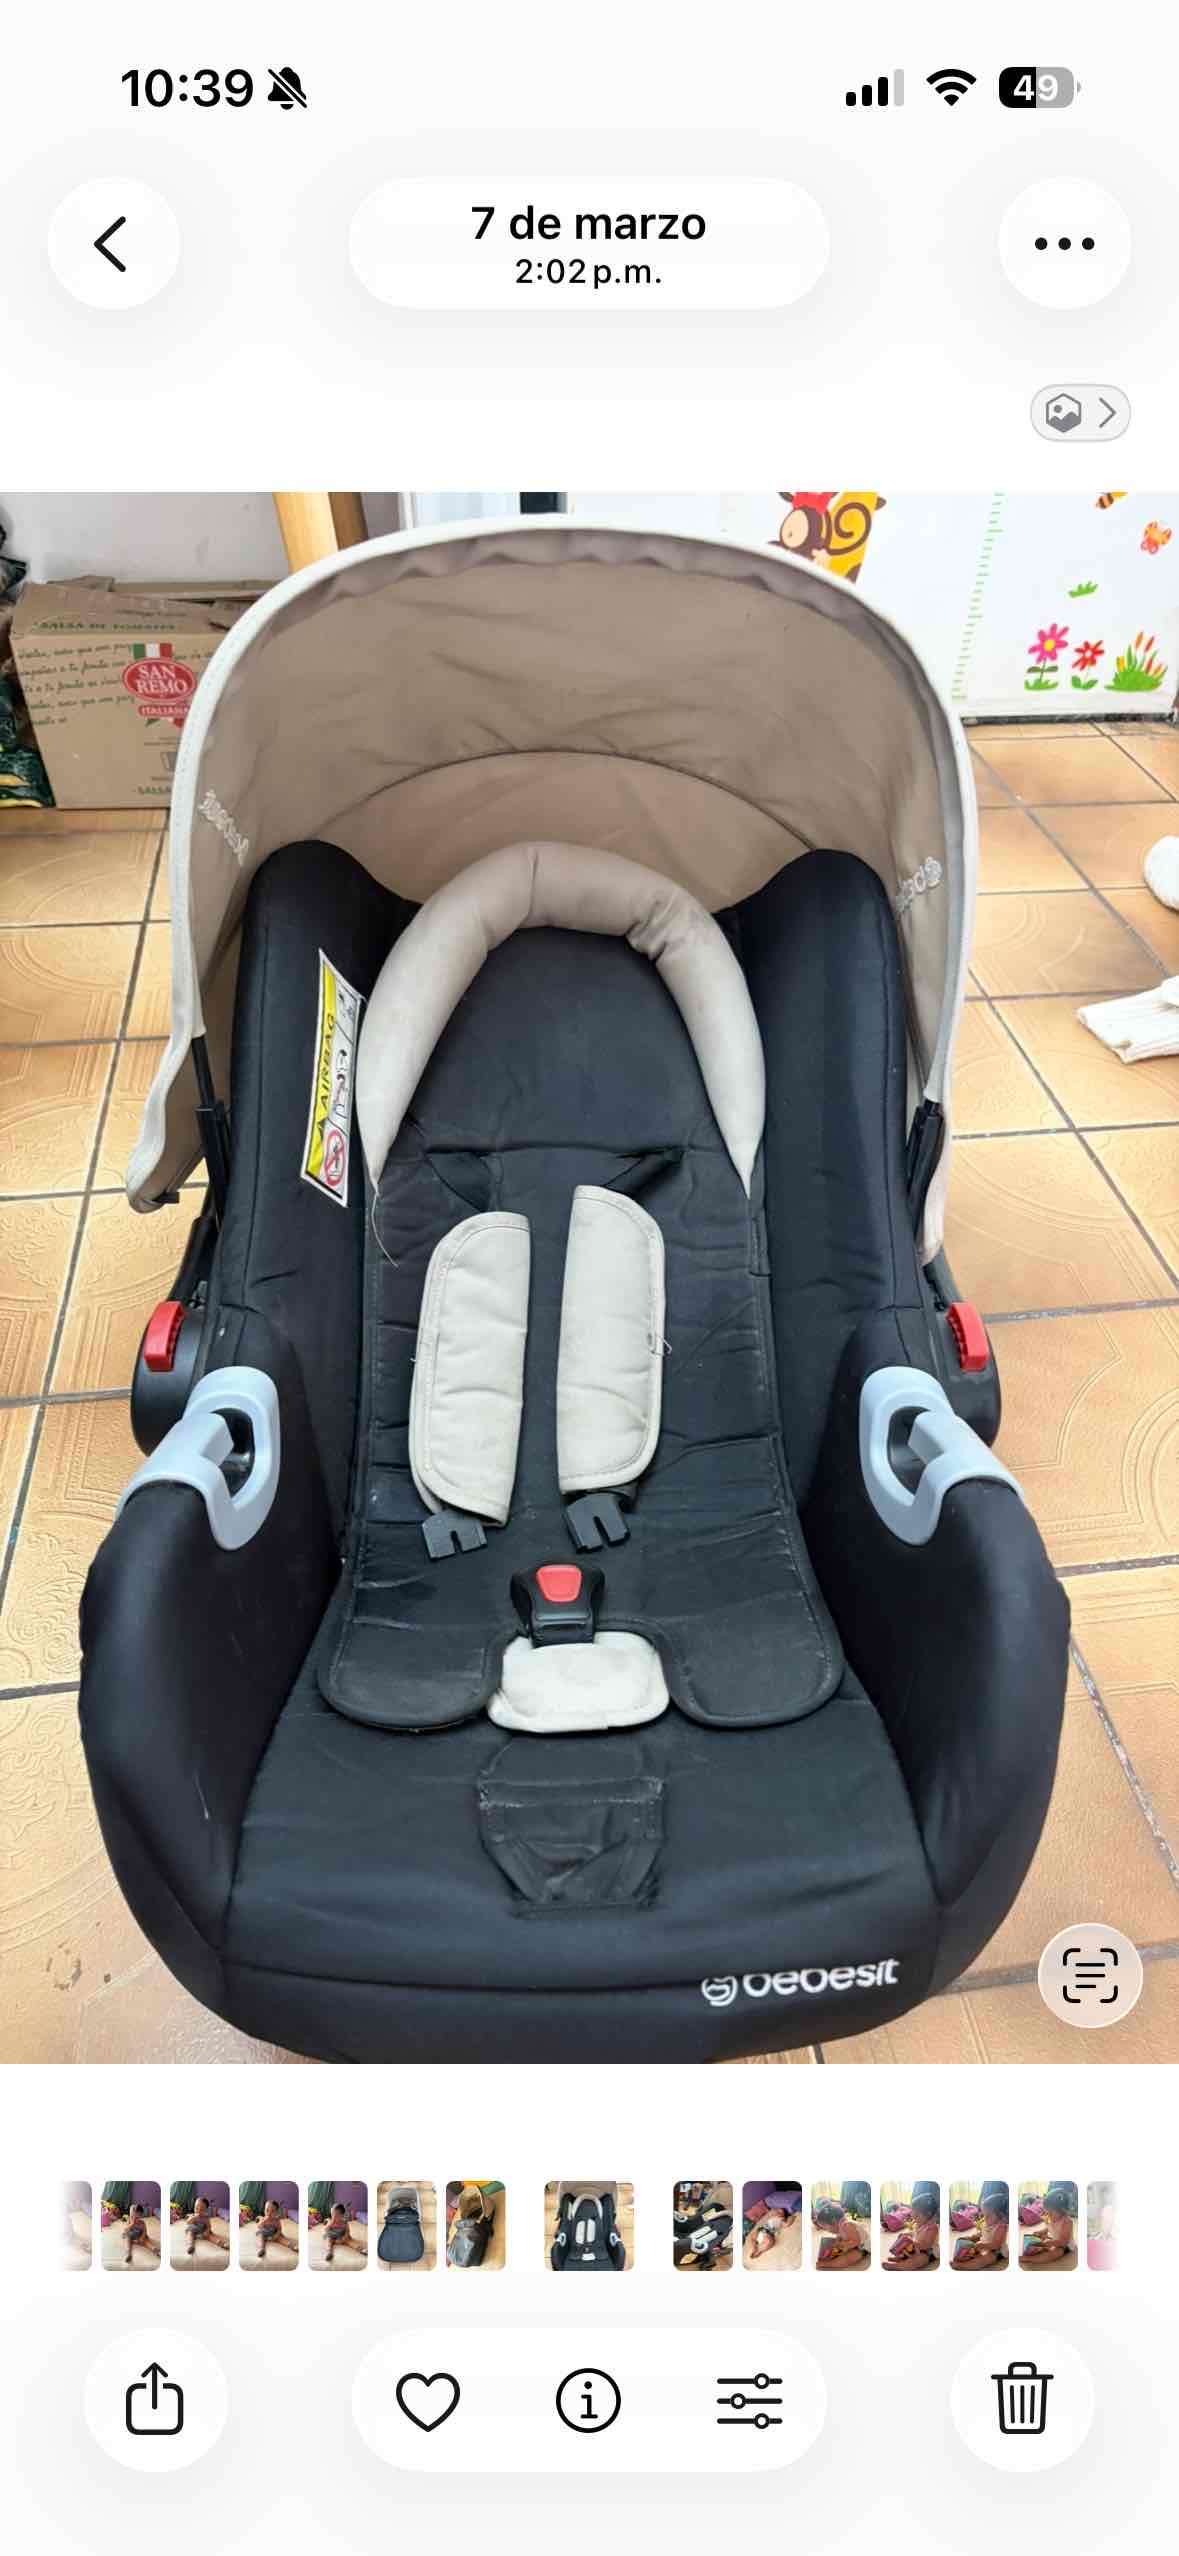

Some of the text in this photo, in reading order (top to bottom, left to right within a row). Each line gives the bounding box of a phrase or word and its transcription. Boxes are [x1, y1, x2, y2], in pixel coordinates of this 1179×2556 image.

[138, 664, 176, 680] SAN
[136, 679, 188, 694] REMO
[319, 1012, 336, 1112] AIRBAG
